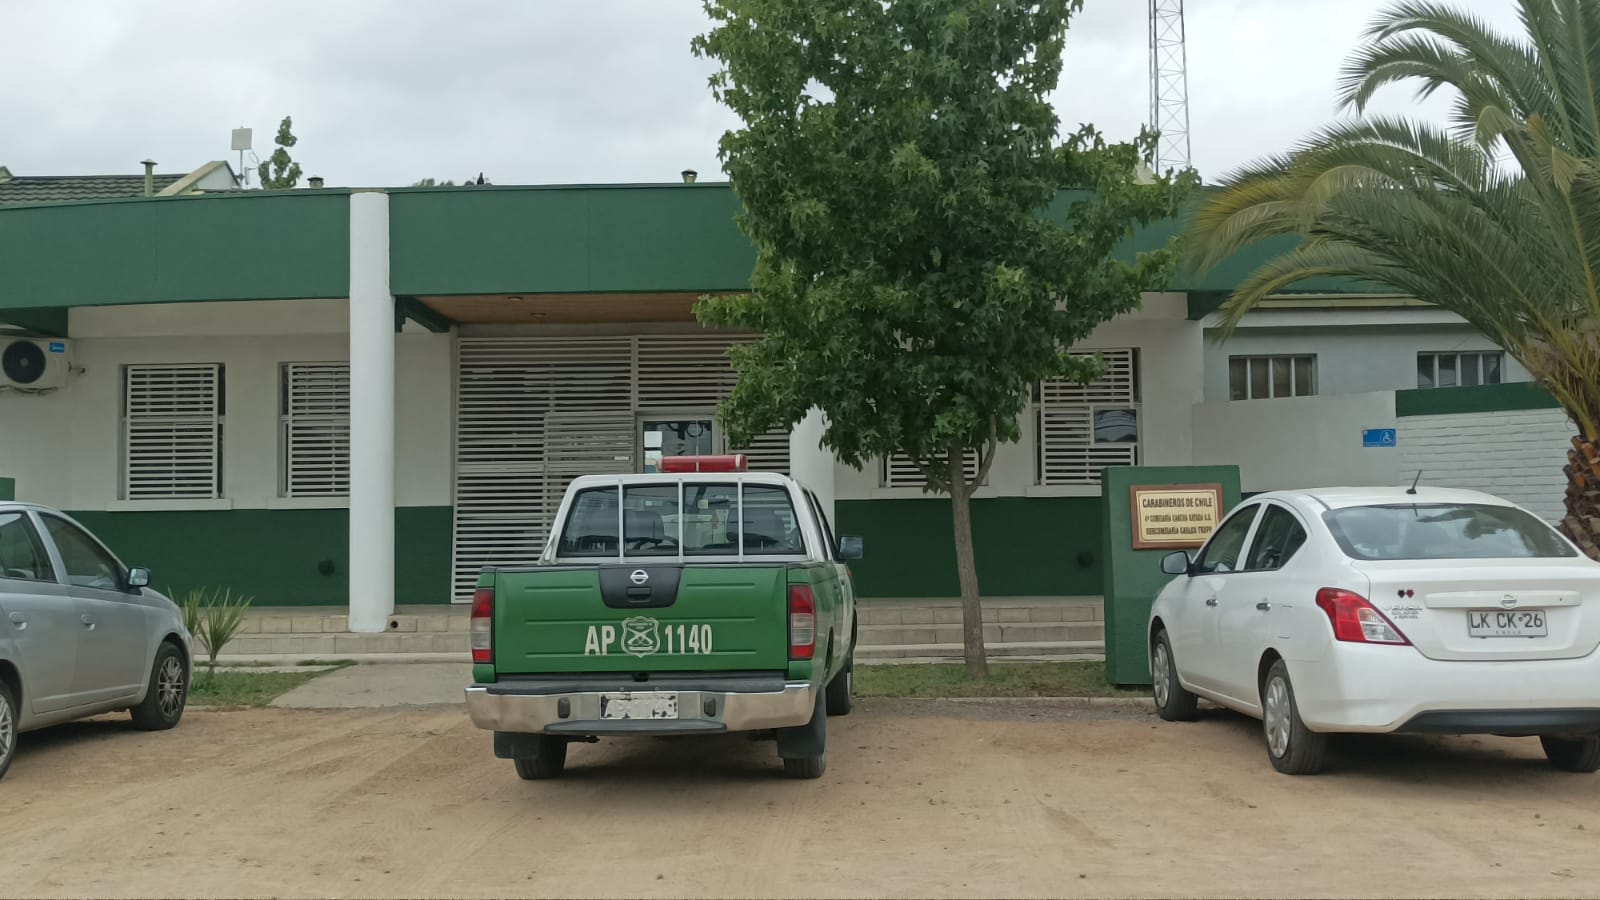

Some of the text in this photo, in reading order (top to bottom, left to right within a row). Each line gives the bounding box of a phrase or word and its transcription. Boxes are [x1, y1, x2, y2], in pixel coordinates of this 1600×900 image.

[1142, 497, 1212, 508] CARABINEROS DE CHILE
[1470, 613, 1490, 628] LK
[584, 624, 713, 656] AP 1140
